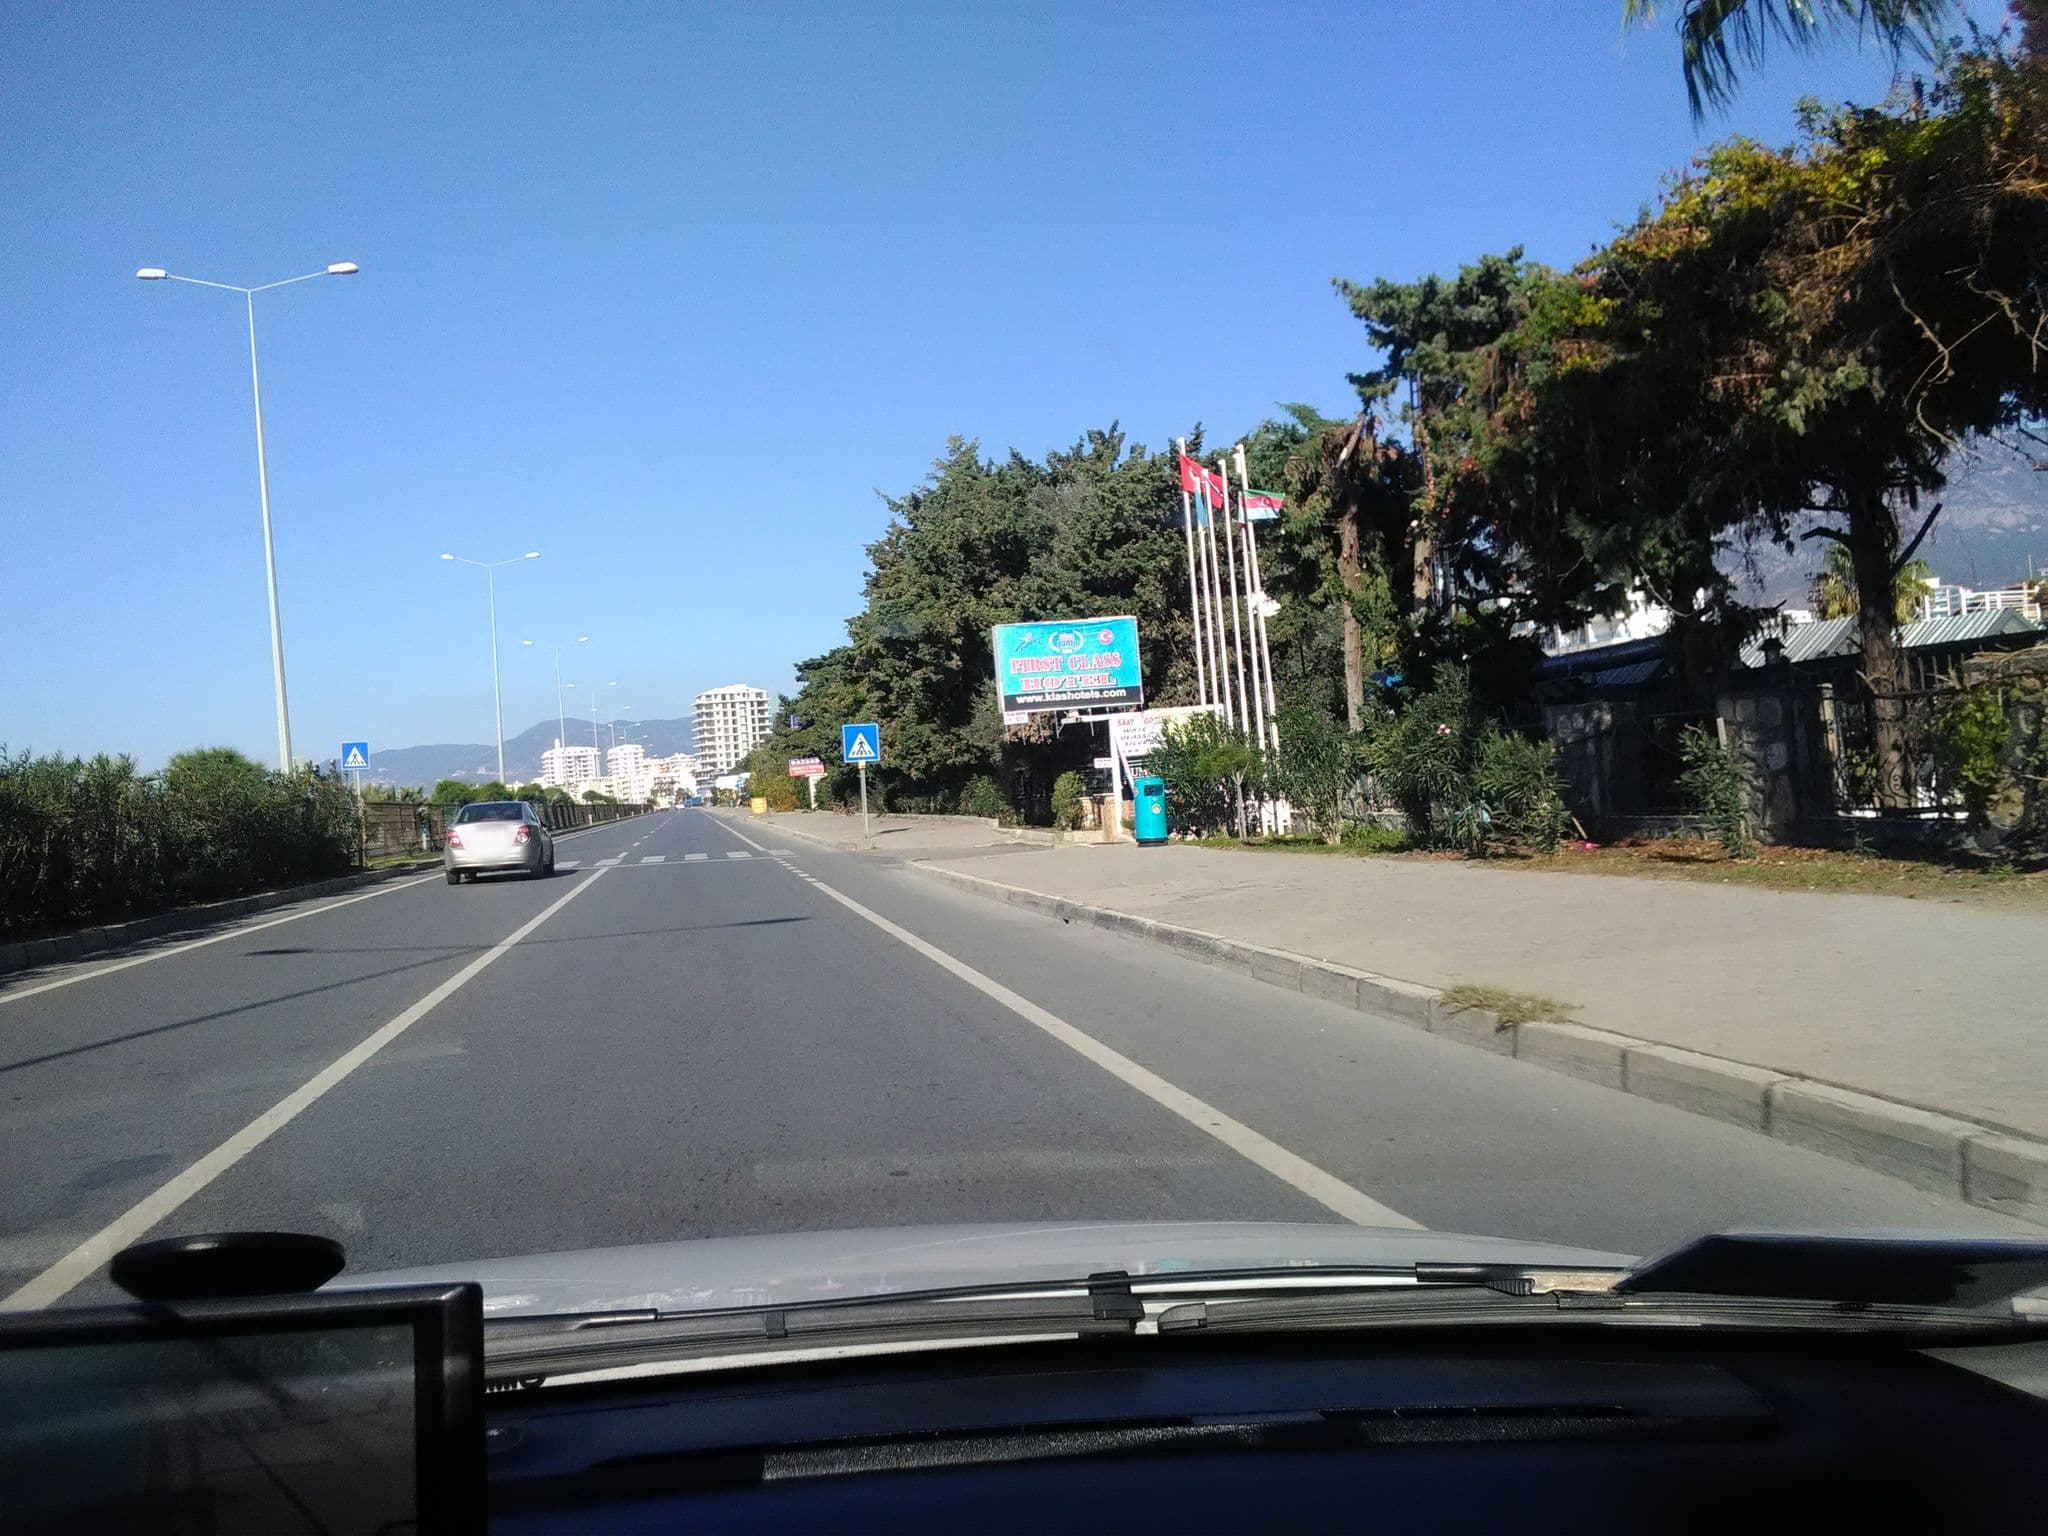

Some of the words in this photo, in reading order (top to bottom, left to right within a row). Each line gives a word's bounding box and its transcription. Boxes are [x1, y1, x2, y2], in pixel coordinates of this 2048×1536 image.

[1011, 656, 1063, 674] FIRST
[1069, 651, 1122, 671] CLASS
[1021, 673, 1118, 691] HOTEL
[1015, 688, 1127, 704] www.klashotels.com
